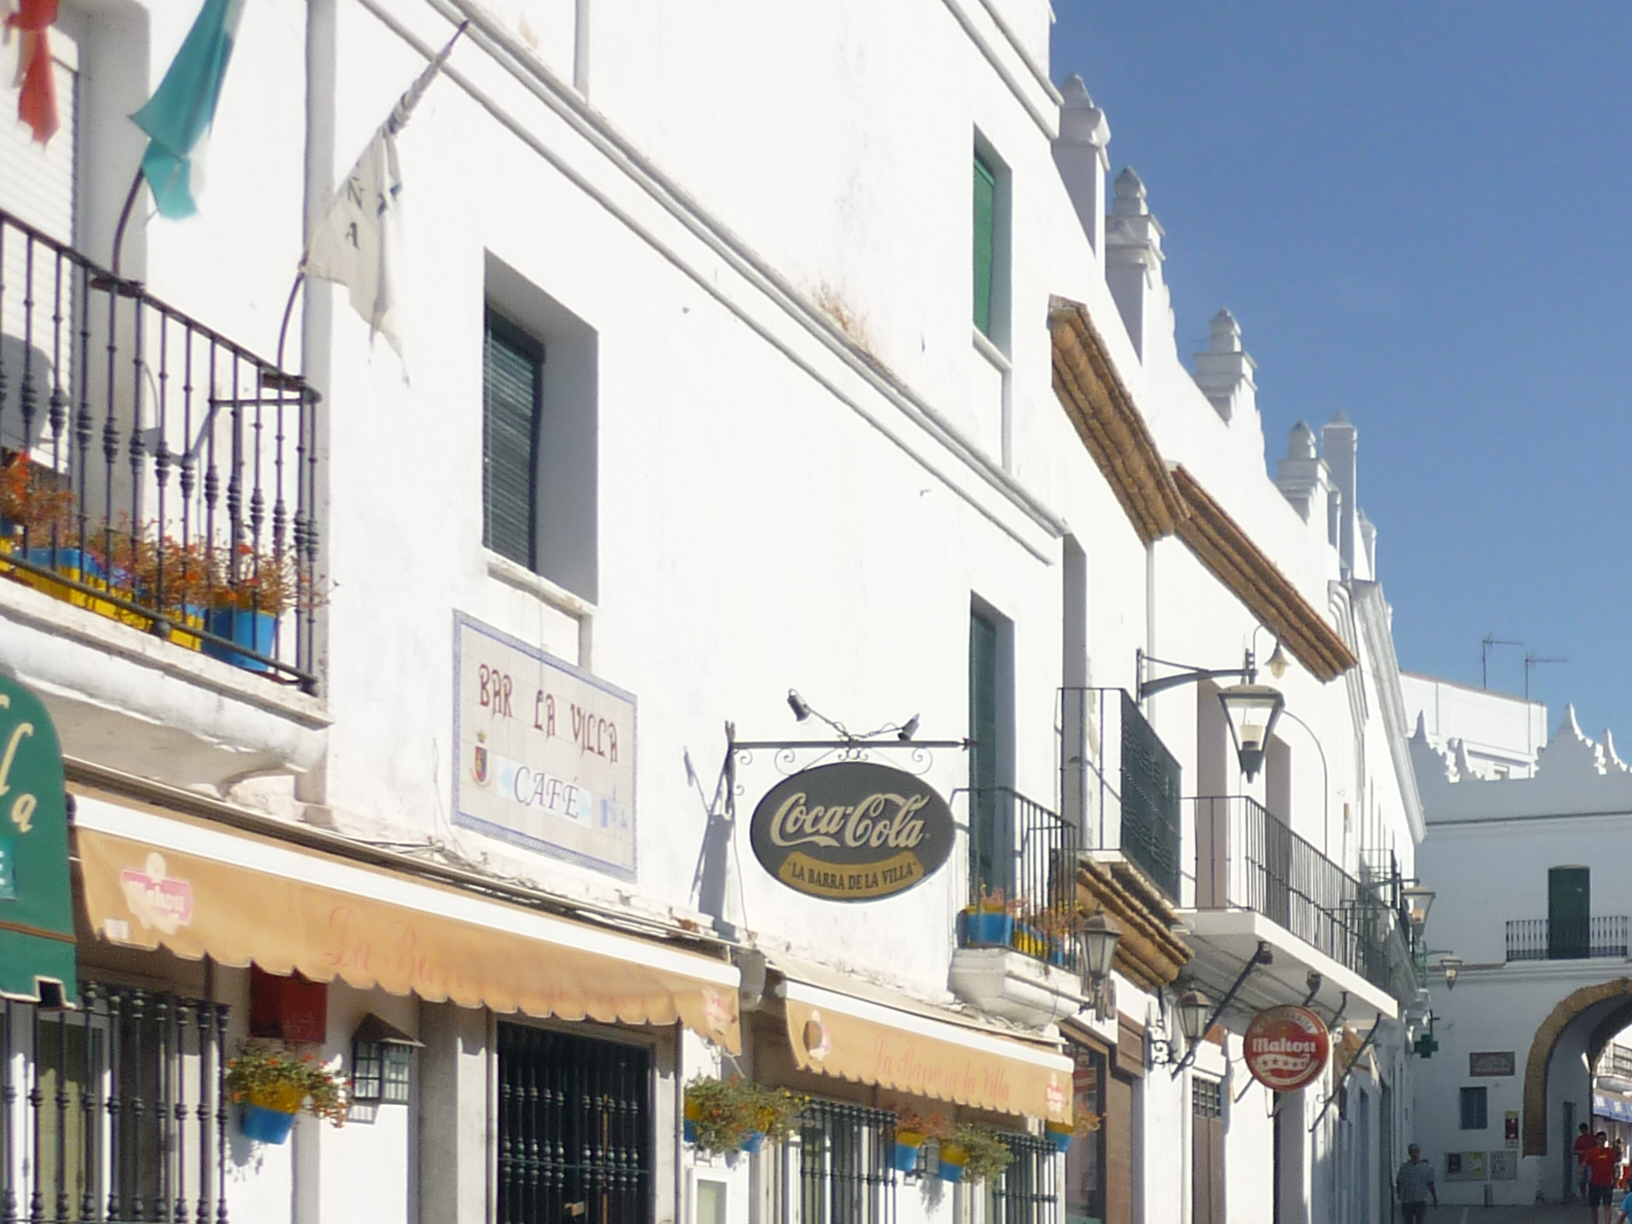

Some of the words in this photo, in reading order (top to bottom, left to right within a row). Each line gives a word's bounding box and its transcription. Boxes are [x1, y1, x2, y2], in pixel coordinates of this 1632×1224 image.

[478, 663, 513, 719] BAR
[533, 688, 556, 739] LA
[570, 702, 619, 764] VILLA
[513, 765, 580, 820] CAFÉ
[770, 791, 931, 849] Coca-Cola
[807, 868, 846, 891] BARRA
[848, 874, 863, 891] DE
[864, 872, 880, 890] LA
[1252, 1036, 1318, 1053] Mahou
